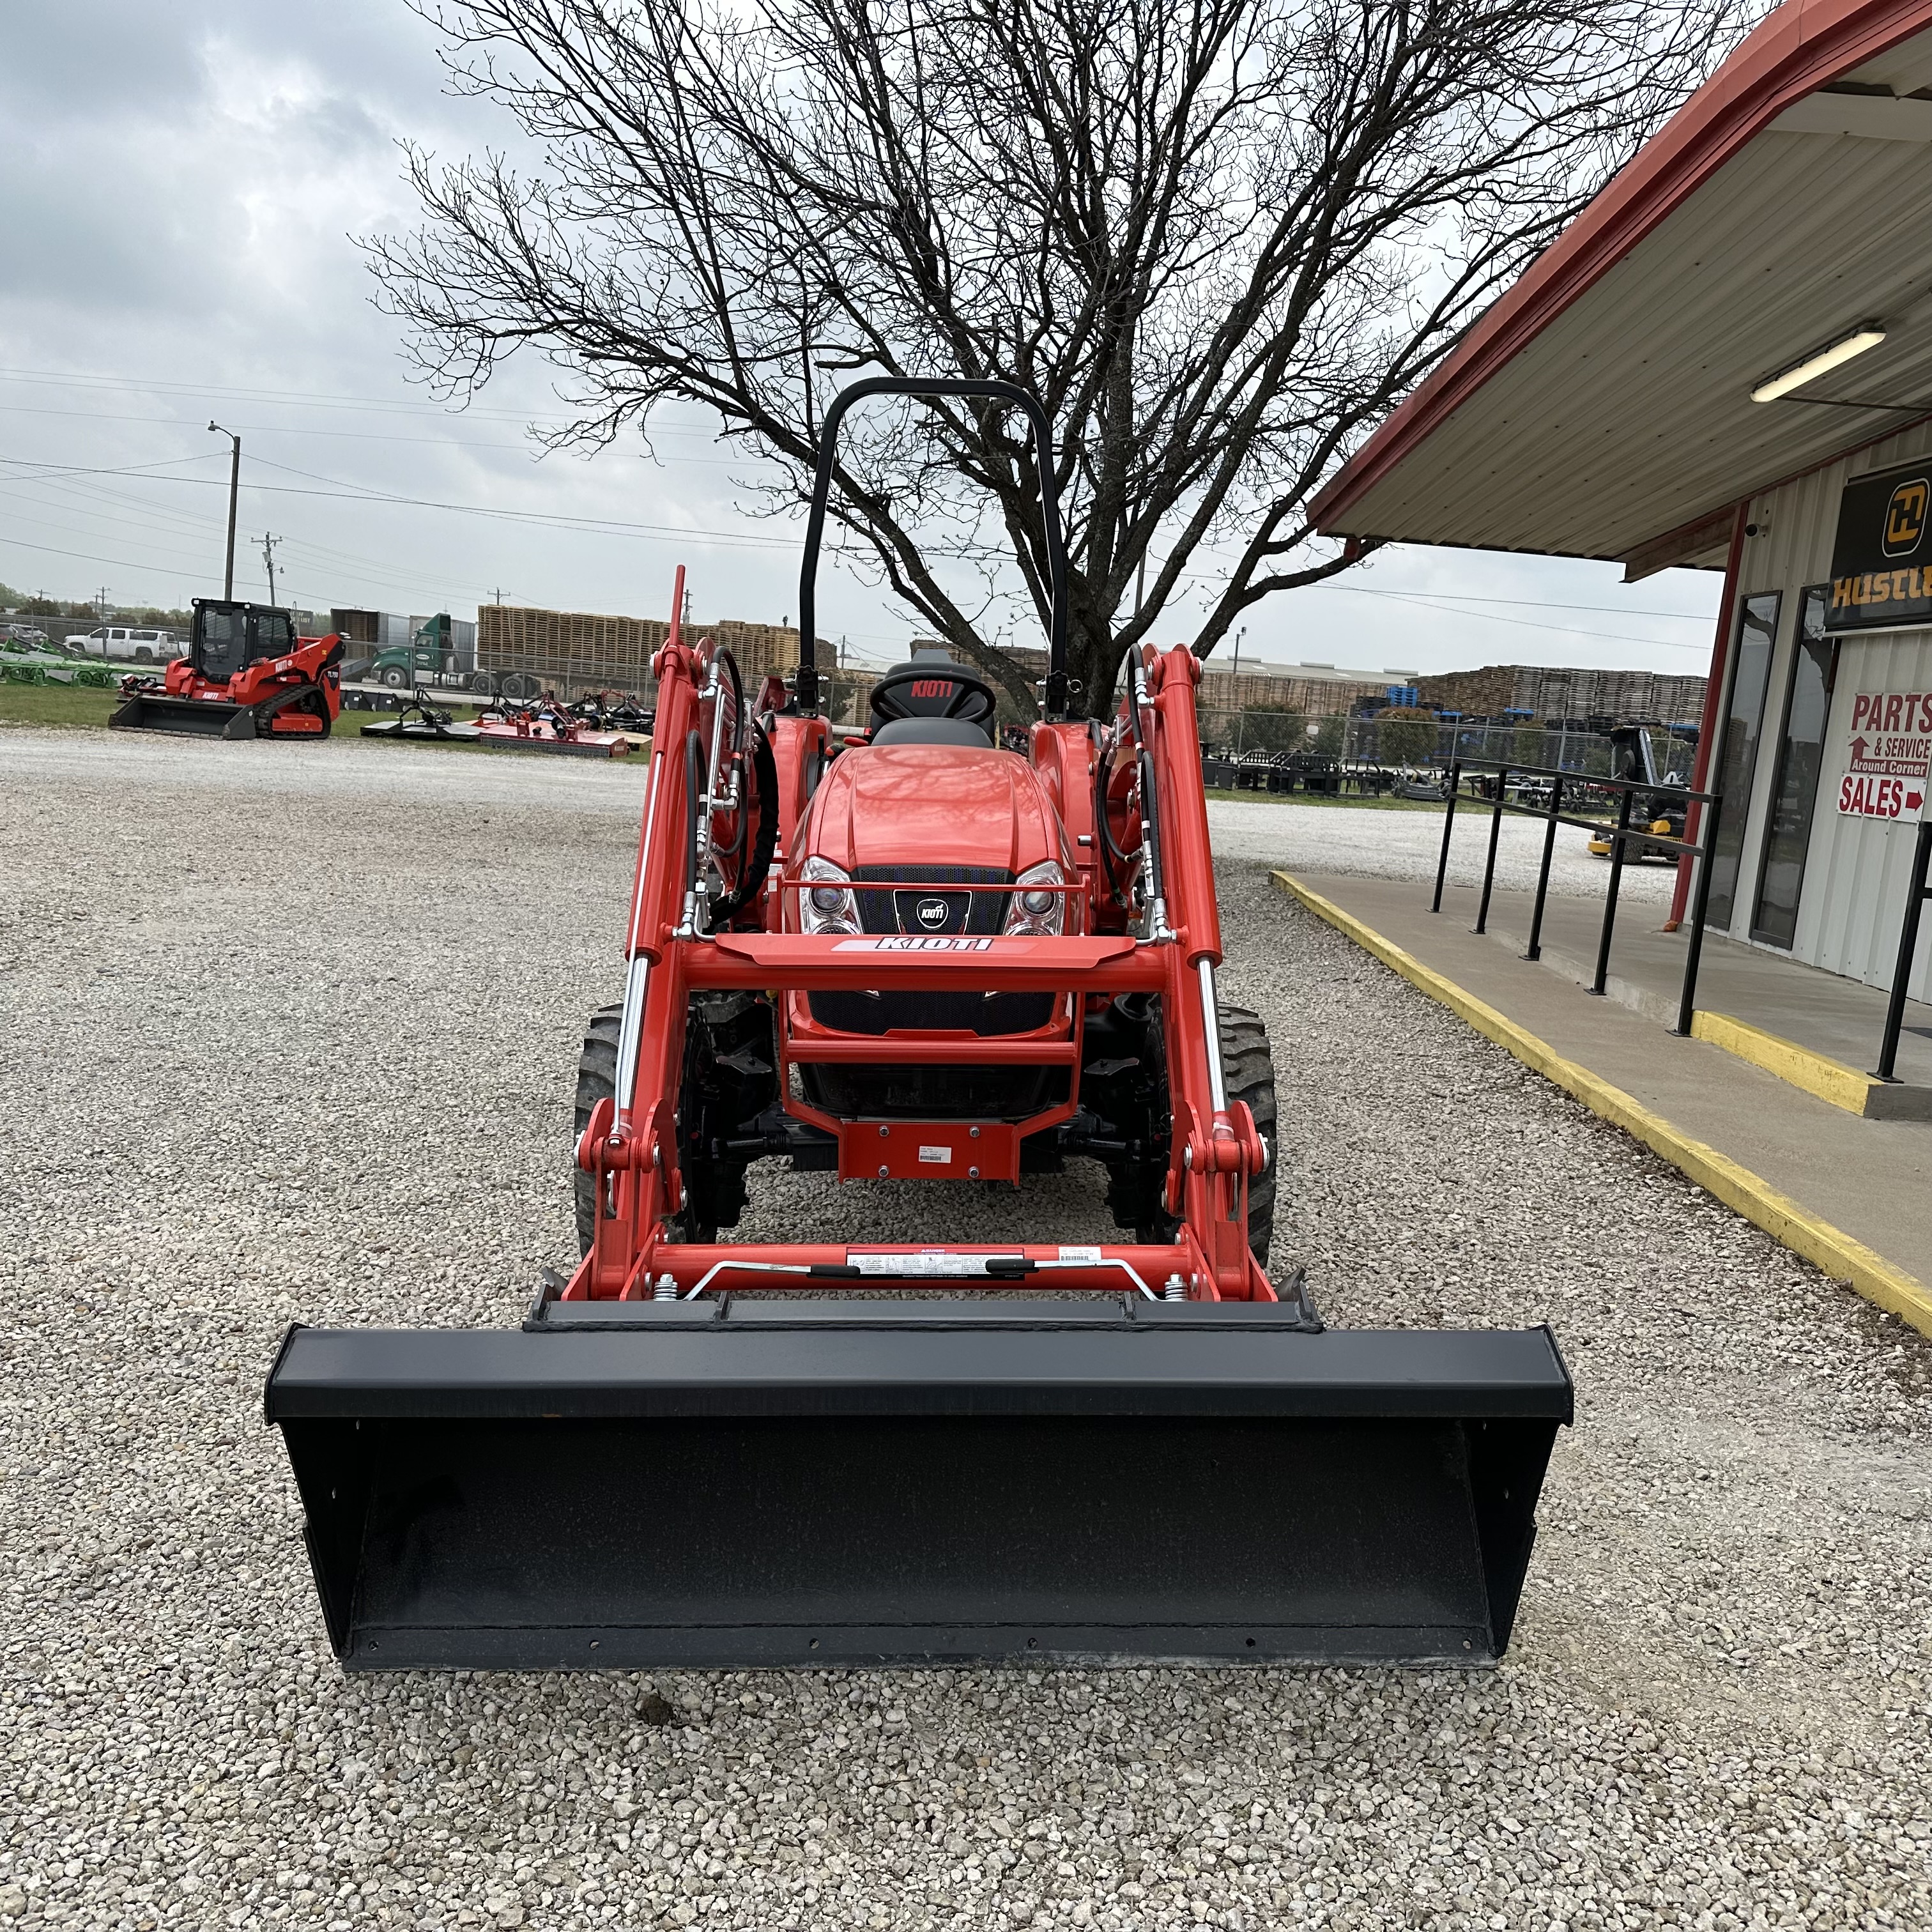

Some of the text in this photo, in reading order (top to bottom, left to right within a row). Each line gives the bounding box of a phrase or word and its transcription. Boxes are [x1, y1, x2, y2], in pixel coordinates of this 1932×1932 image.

[911, 680, 953, 697] KIOTI
[1851, 693, 1932, 733] PARTS
[1874, 737, 1931, 759] & SERVICE
[1851, 758, 1926, 776] Around Corner
[1839, 776, 1903, 818] SALES
[921, 908, 944, 919] KIOTI
[875, 937, 995, 951] KIOTI
